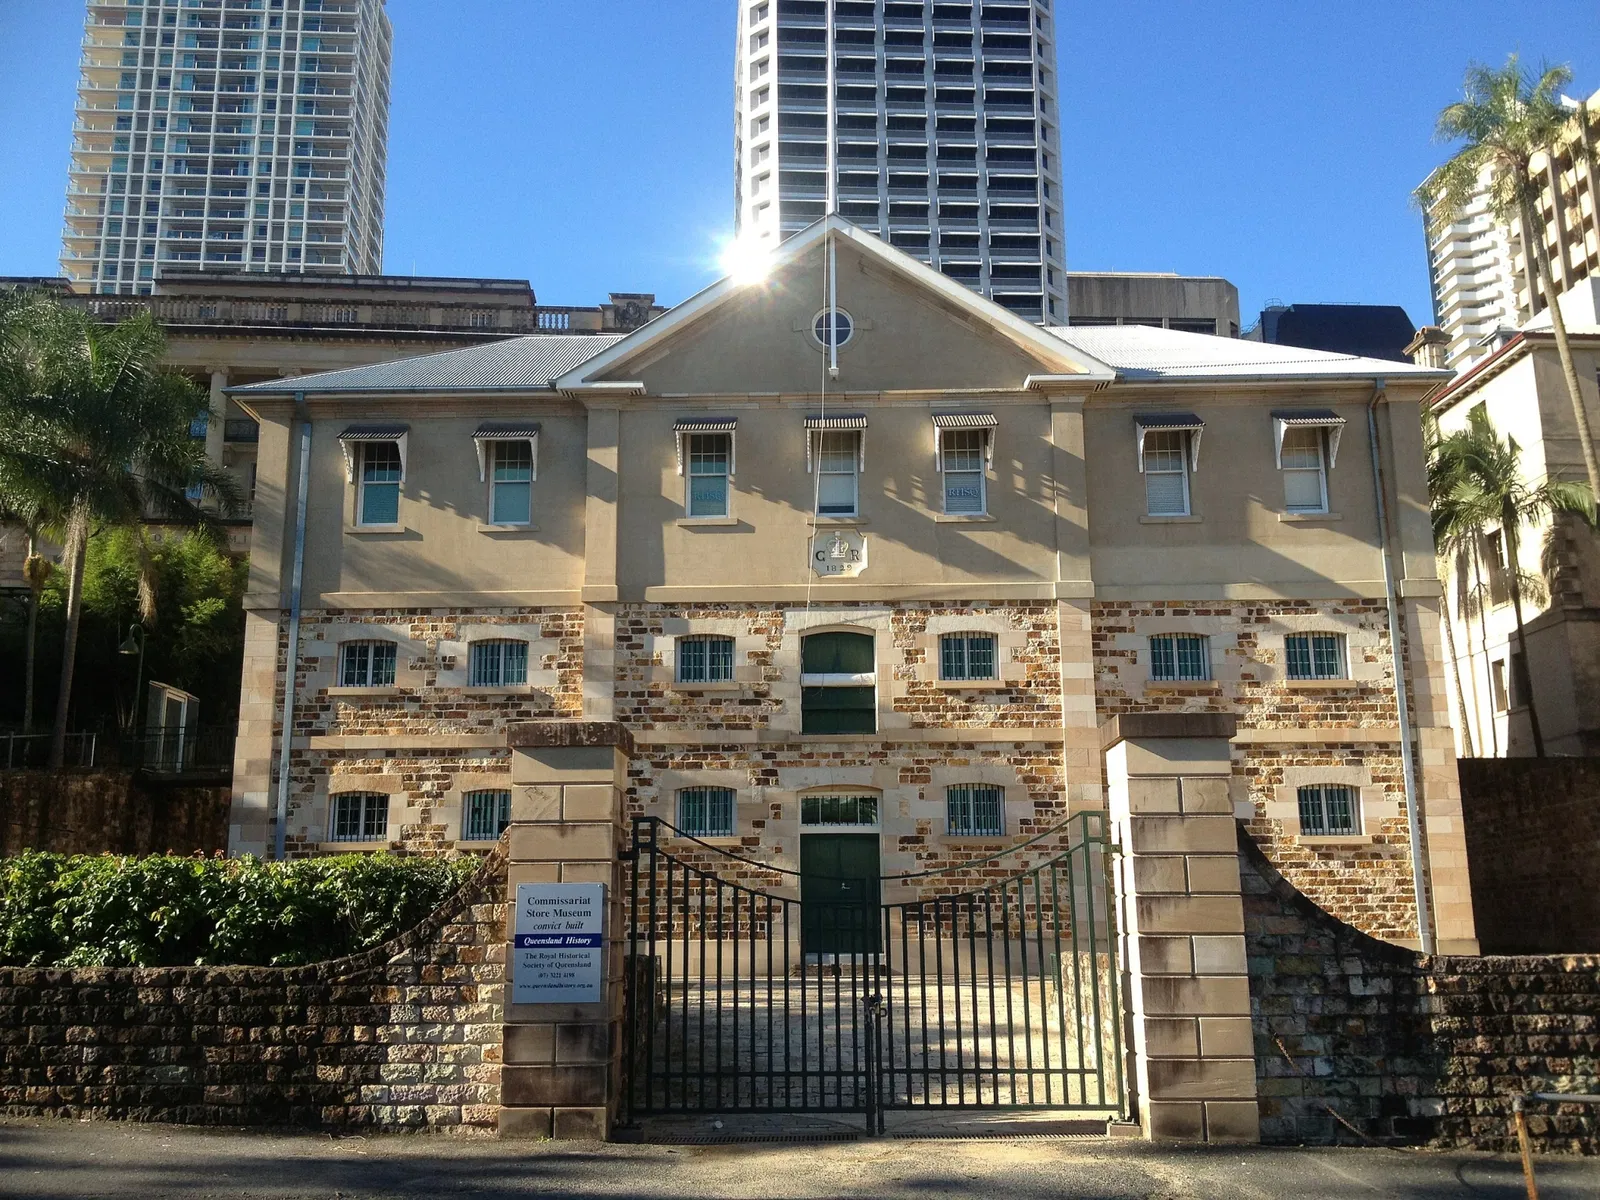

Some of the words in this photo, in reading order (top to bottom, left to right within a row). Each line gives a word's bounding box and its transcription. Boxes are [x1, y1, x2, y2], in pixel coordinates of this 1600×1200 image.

[850, 549, 860, 562] R
[826, 564, 853, 572] 1829
[527, 896, 591, 906] Commissariat
[526, 909, 550, 918] Store
[552, 908, 592, 918] Museum
[533, 921, 562, 930] convict
[565, 921, 584, 930] built
[524, 937, 563, 946] Queensland
[565, 937, 592, 945] History
[525, 952, 537, 960] The
[539, 952, 557, 960] Royal
[522, 962, 545, 970] Society
[546, 961, 554, 969] of
[554, 961, 592, 970] Queensland
